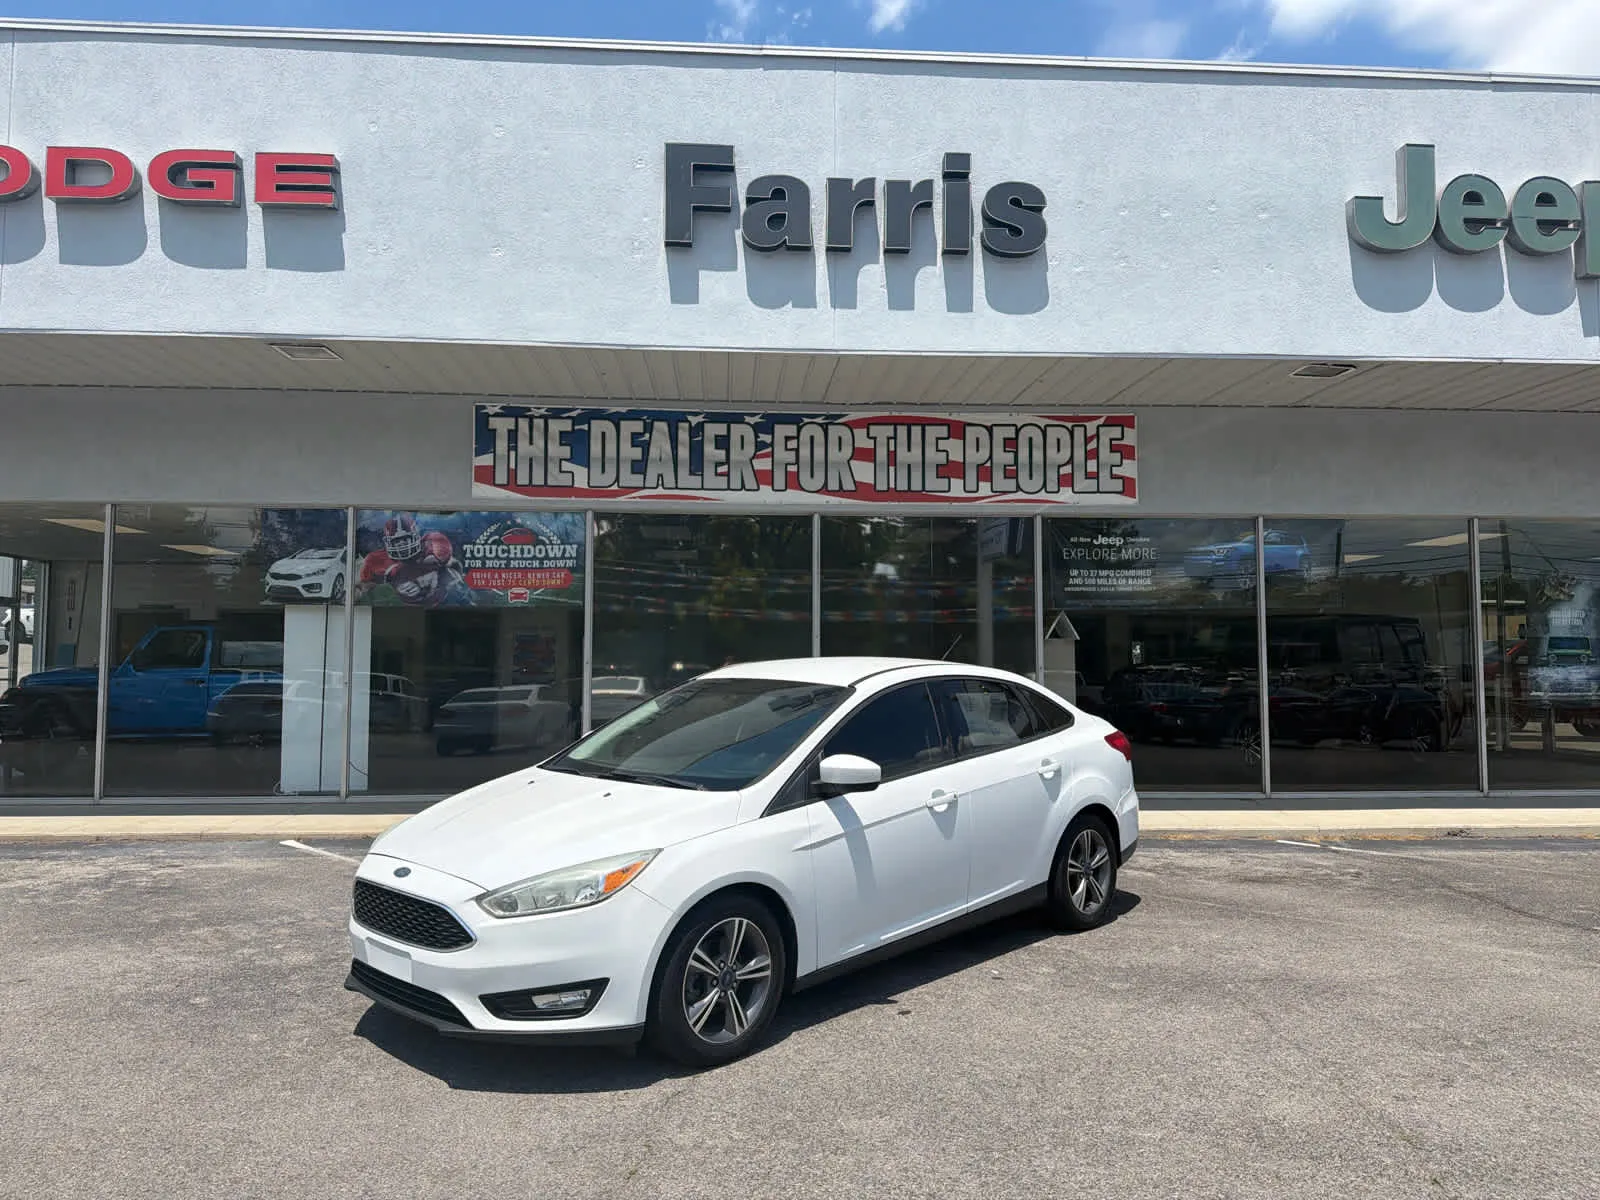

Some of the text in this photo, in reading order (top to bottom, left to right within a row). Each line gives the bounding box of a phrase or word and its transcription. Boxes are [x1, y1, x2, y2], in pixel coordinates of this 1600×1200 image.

[664, 142, 1048, 258] Farris
[488, 415, 1125, 494] THE DEALER FOR THE PEOPLE
[1092, 534, 1124, 546] Jeep
[463, 544, 578, 558] TOUCHDOWN
[1063, 548, 1157, 560] EXPLORE MORE
[464, 559, 577, 568] FOR NOT MUCH DOWN!
[1115, 569, 1152, 577] COMBINED
[1069, 577, 1083, 585] AND
[1097, 577, 1117, 585] MILES
[1128, 577, 1152, 585] RANGE
